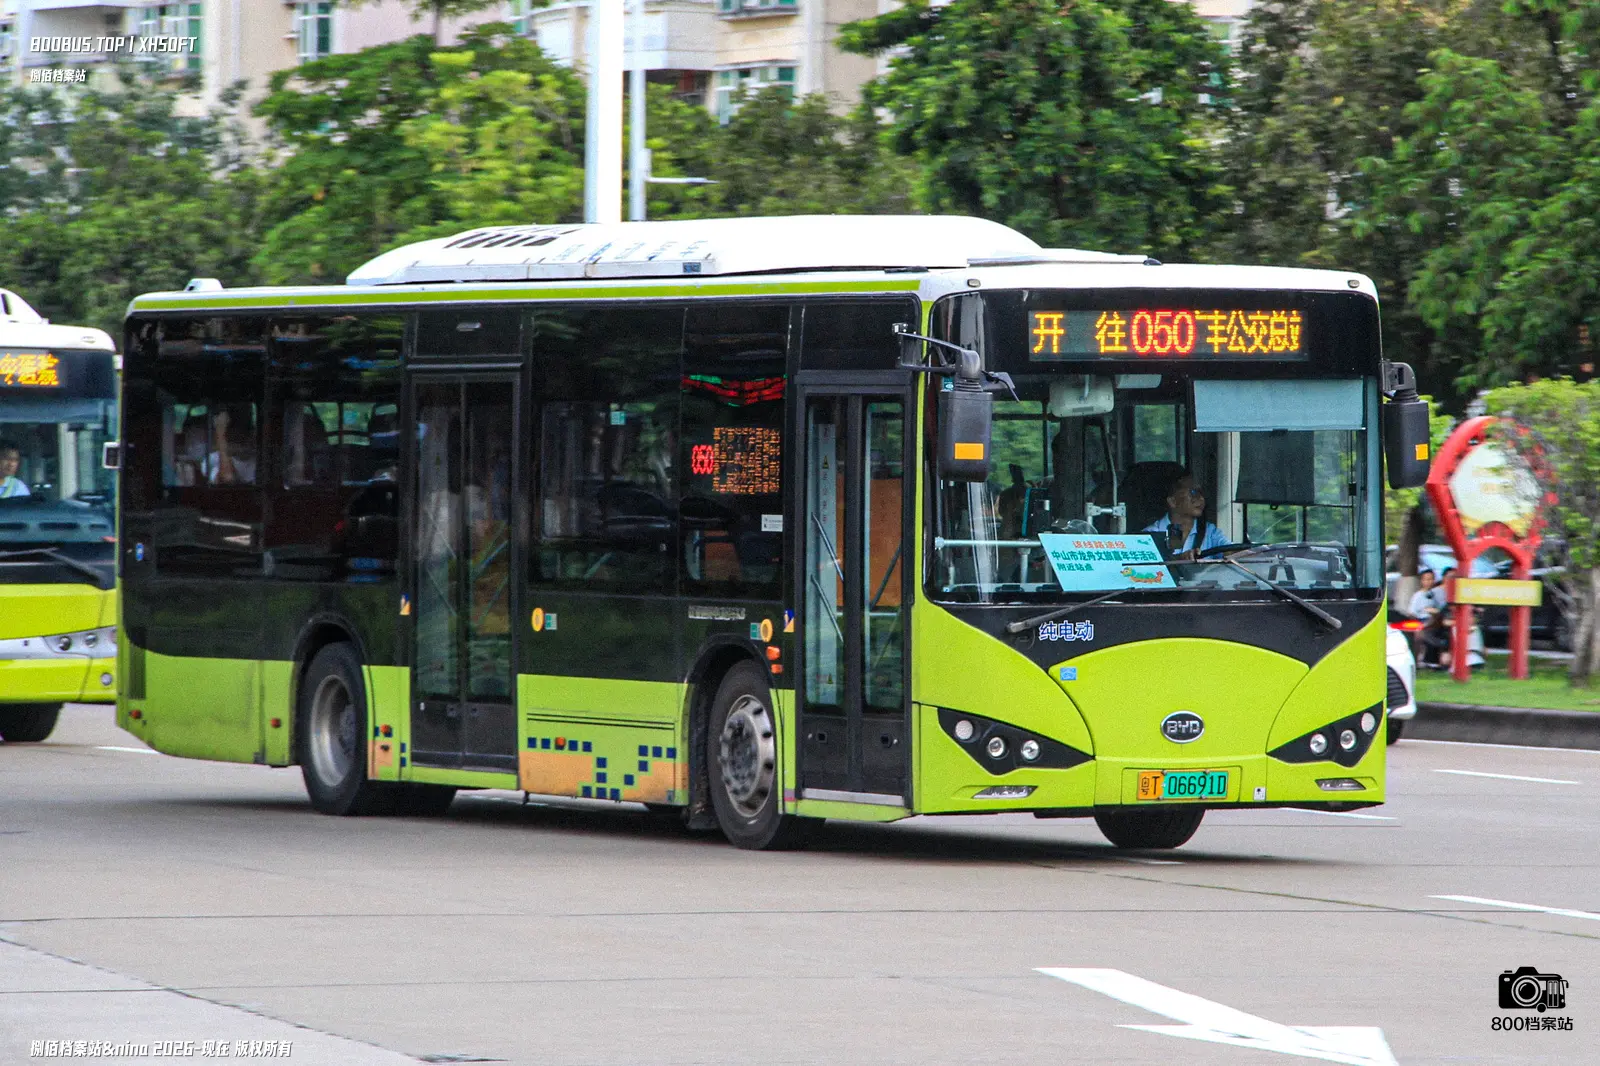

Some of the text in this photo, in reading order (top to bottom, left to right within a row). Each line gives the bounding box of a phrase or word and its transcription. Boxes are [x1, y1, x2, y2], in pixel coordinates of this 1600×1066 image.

[1130, 309, 1196, 354] 050
[1038, 620, 1095, 642] 纯电动
[1165, 719, 1200, 734] BYD
